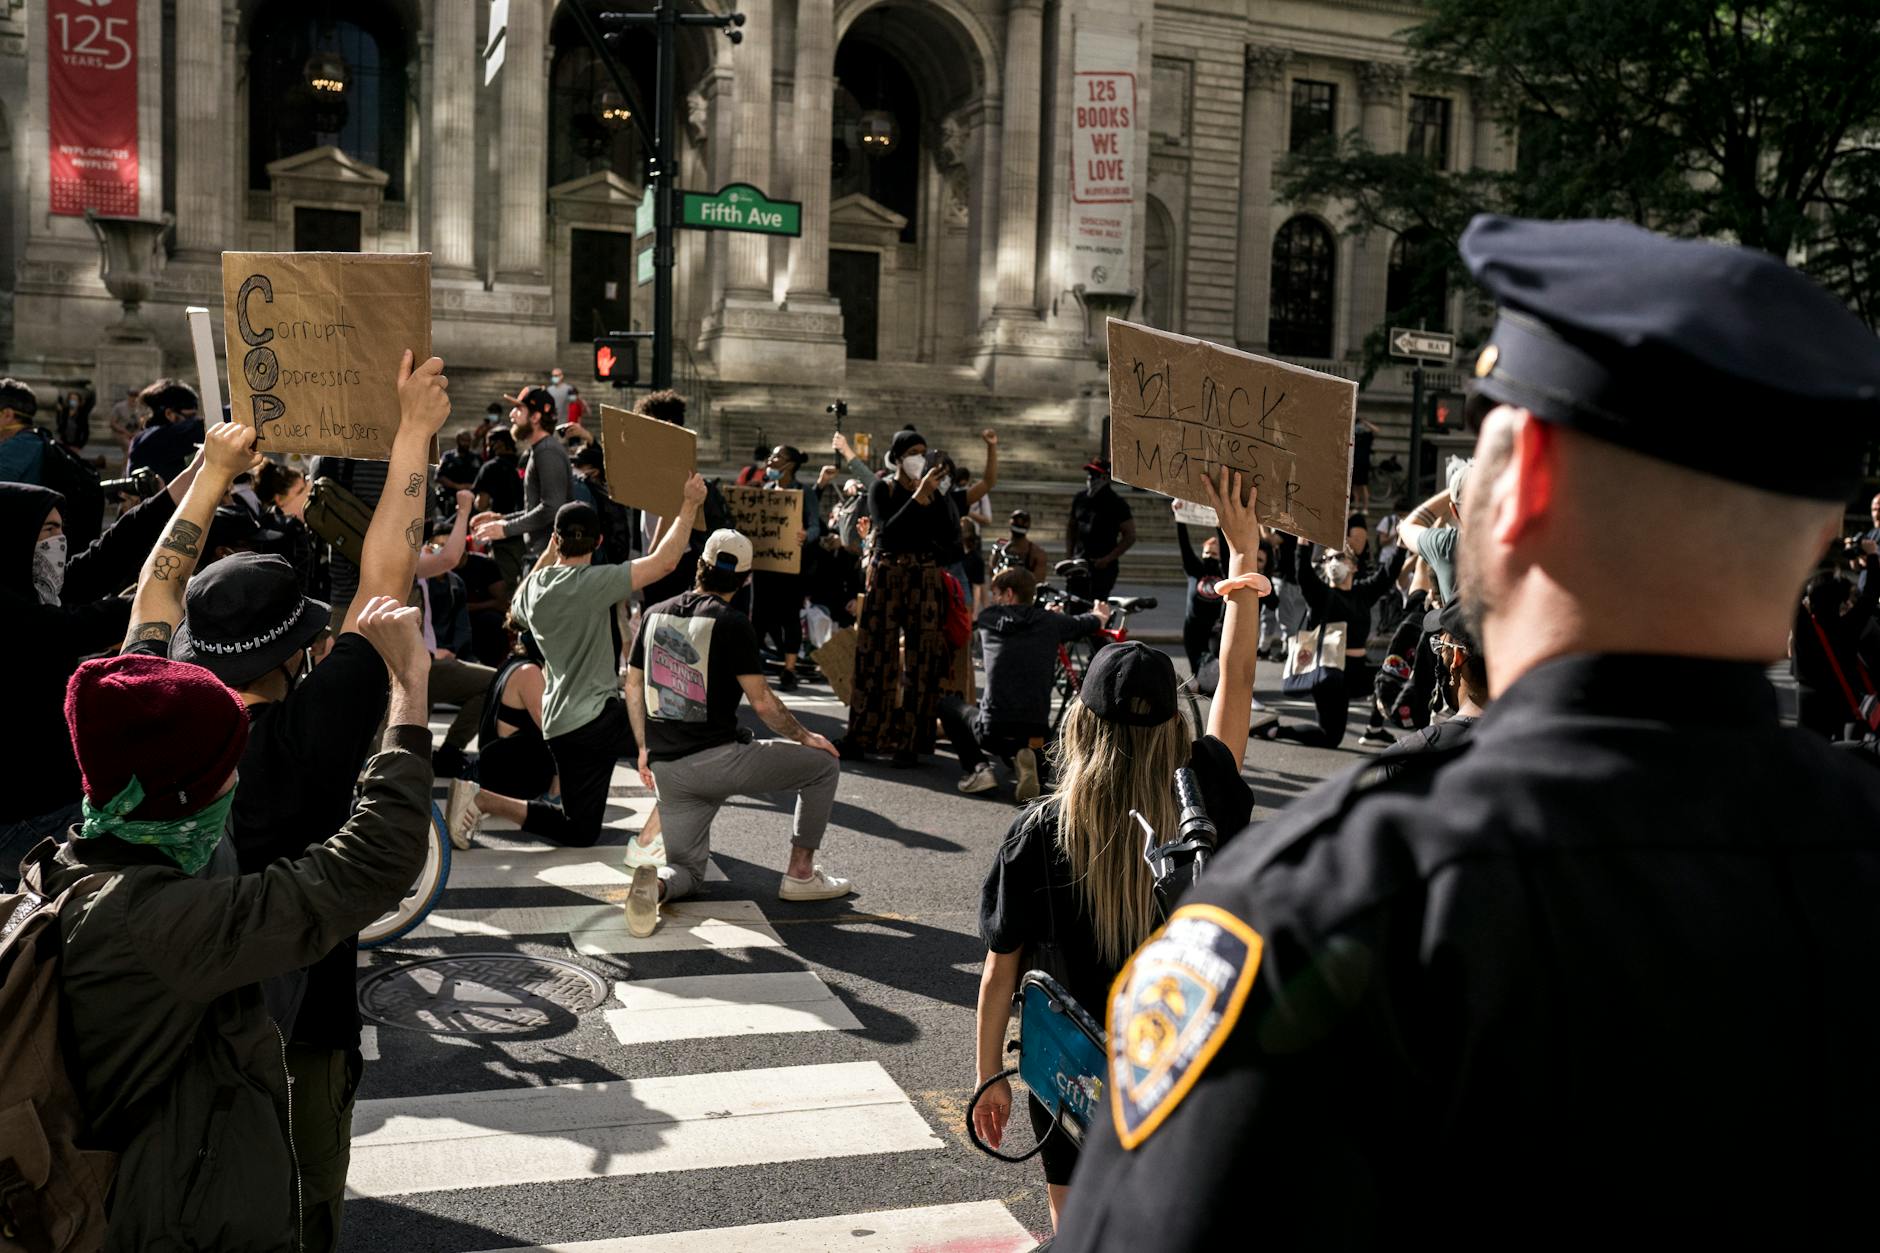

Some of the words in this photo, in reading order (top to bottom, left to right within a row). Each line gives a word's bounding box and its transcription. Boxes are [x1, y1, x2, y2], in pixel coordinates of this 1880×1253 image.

[54, 13, 131, 70] 125
[63, 54, 103, 67] YEARS
[1088, 80, 1117, 101] 125
[1077, 106, 1129, 129] BOOKS
[1091, 133, 1119, 155] WE
[1088, 159, 1125, 181] LOVE
[701, 202, 742, 223] Fifth
[747, 207, 782, 227] Ave
[237, 274, 355, 346] Corrupt
[1401, 338, 1417, 349] ONE
[1427, 341, 1446, 351] WAY
[244, 346, 361, 392] Oppressors
[249, 393, 311, 441] Power
